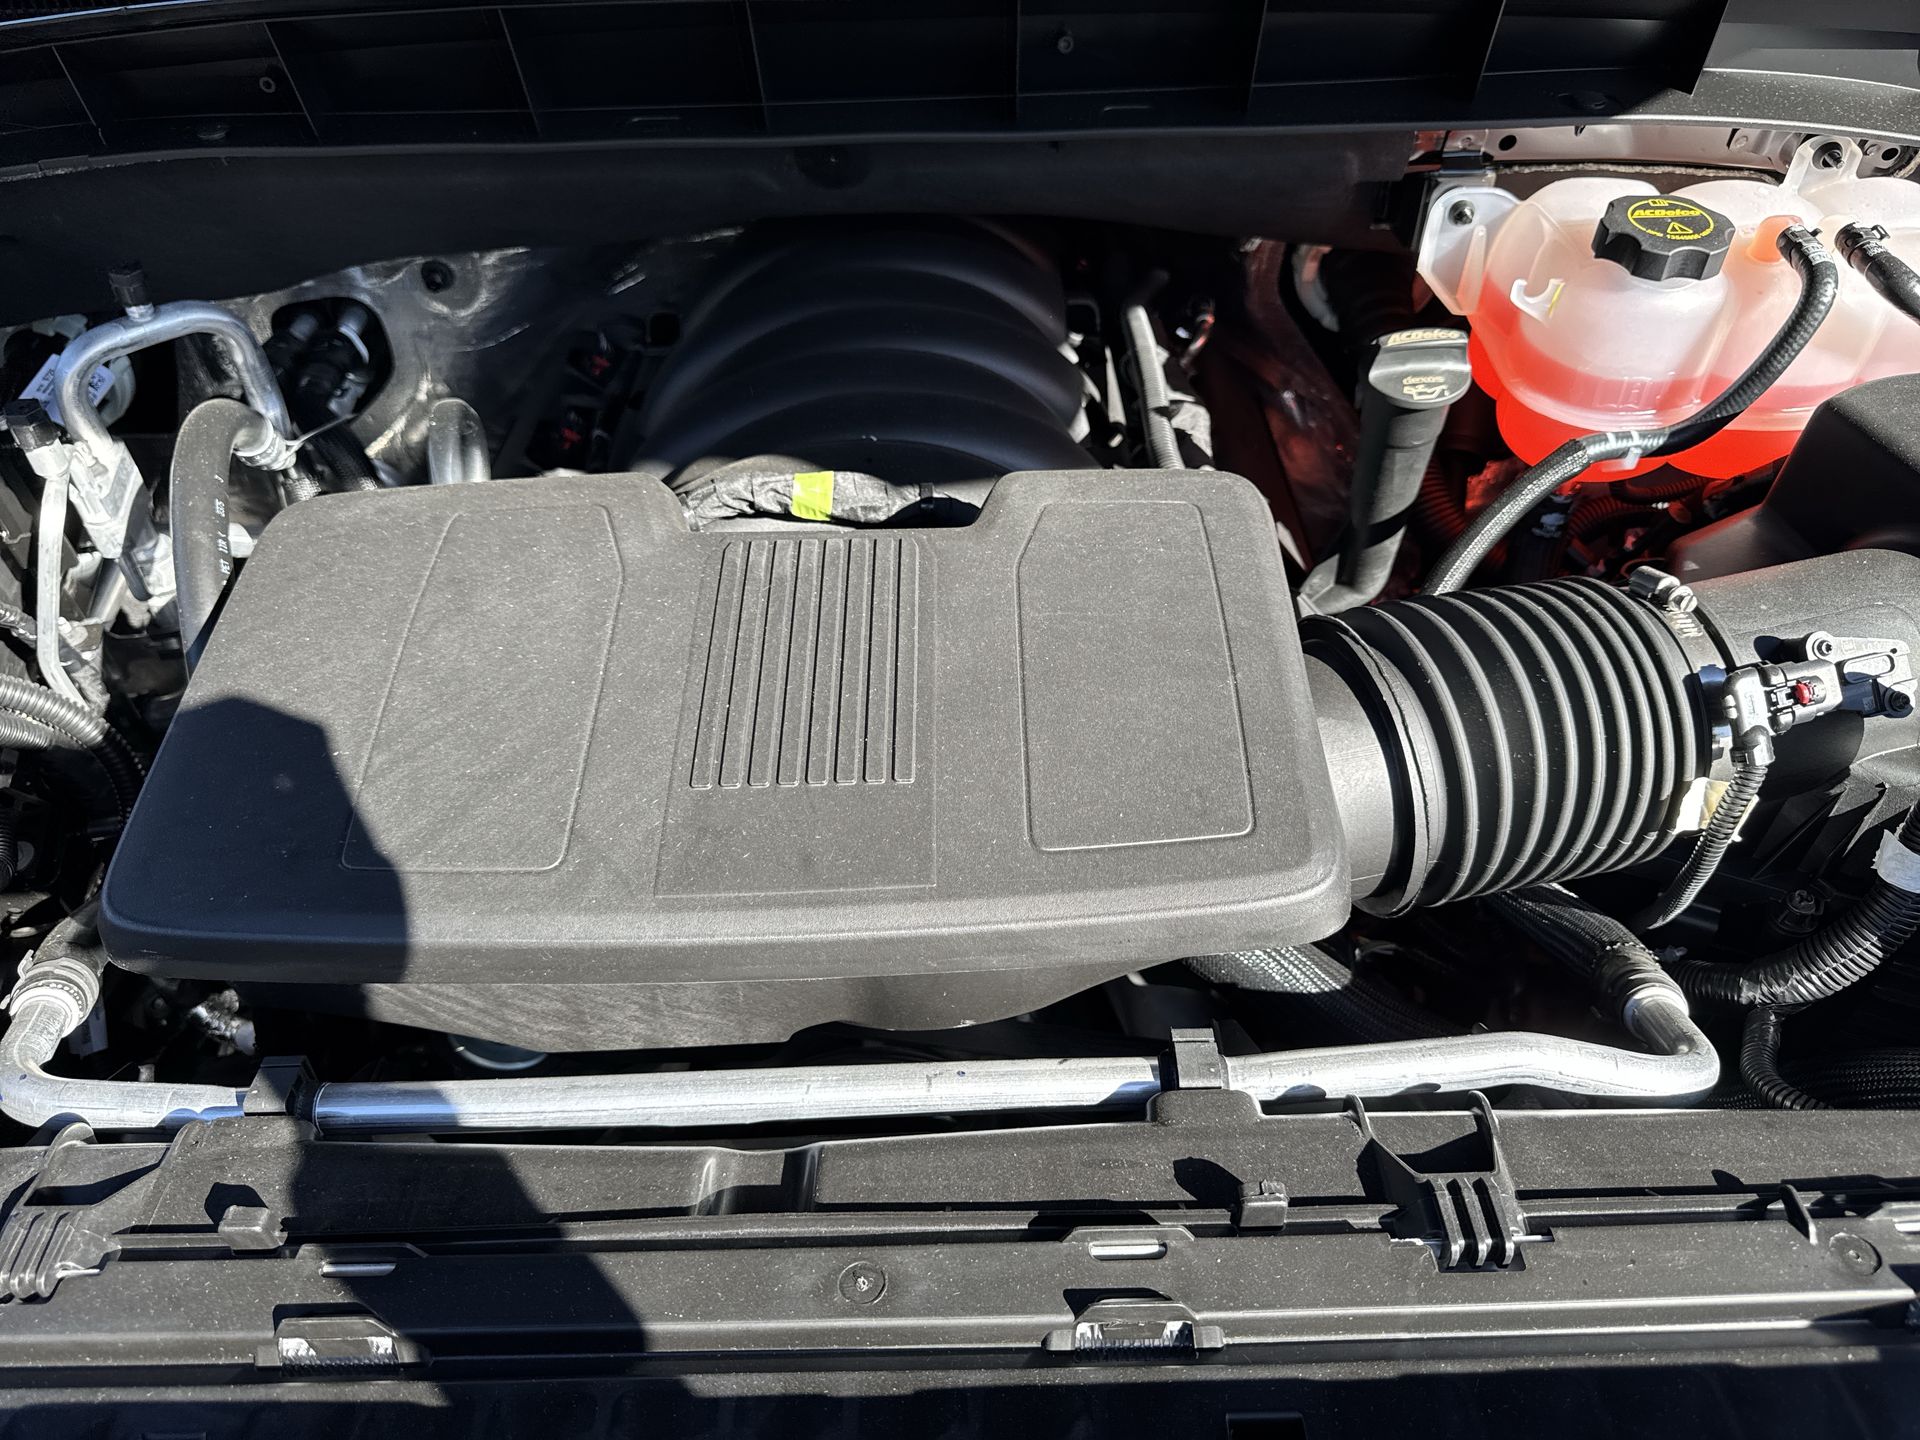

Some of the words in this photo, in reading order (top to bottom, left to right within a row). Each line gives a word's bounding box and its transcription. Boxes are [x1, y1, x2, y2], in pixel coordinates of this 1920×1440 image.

[1632, 209, 1701, 218] ACDelco
[1387, 329, 1460, 346] ACDelco
[1402, 375, 1445, 385] dexos
